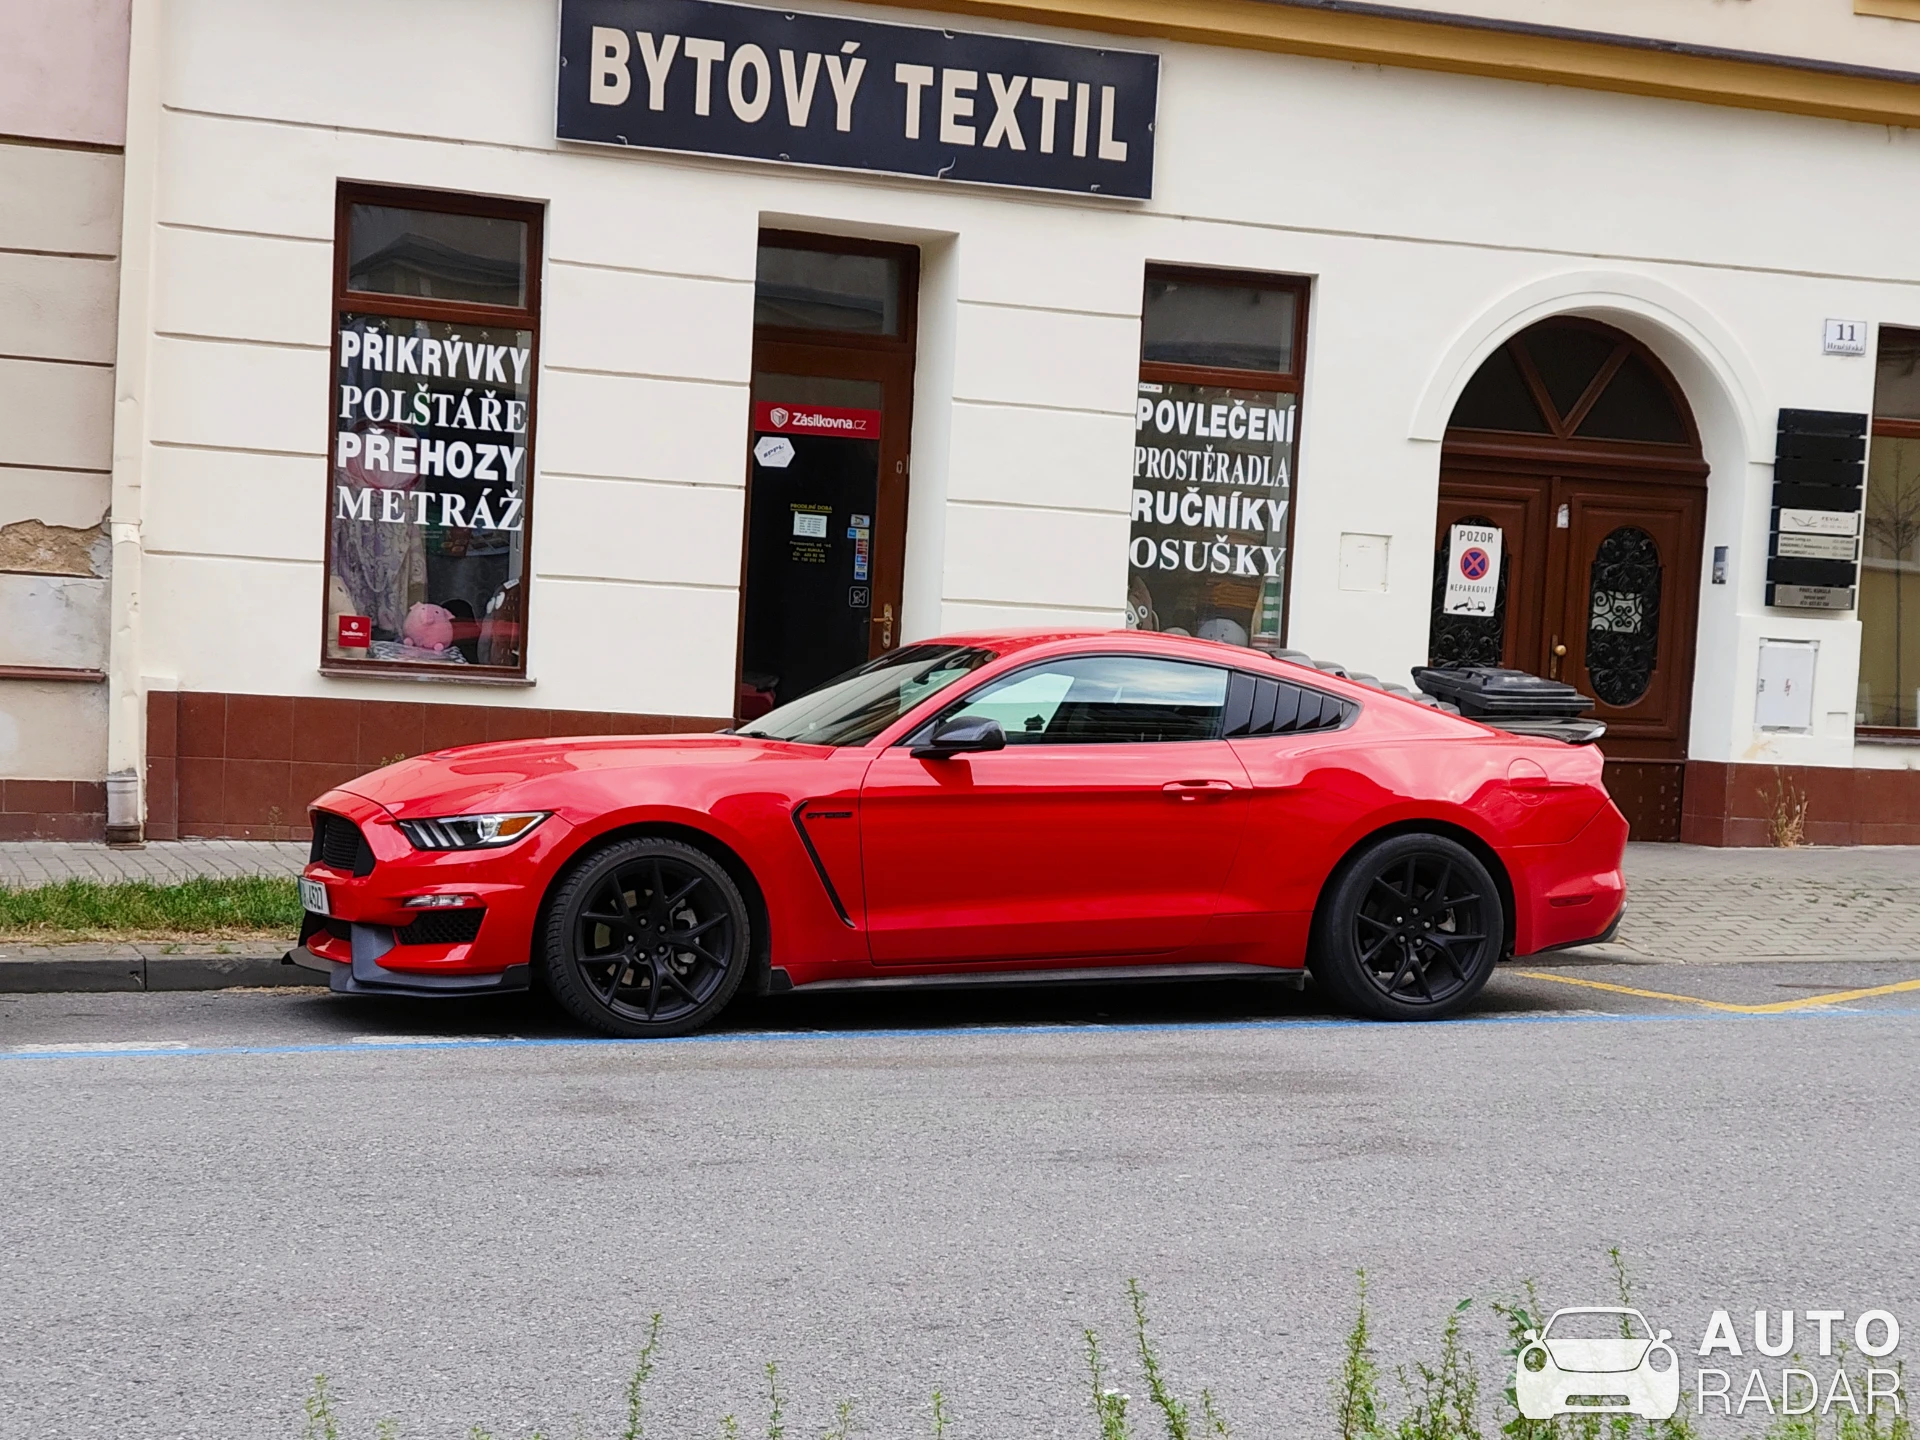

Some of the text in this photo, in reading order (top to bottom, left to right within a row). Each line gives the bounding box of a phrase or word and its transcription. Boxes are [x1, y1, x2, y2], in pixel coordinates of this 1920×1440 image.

[590, 26, 1127, 162] BYTOVÝ TEXTIL
[1836, 323, 1856, 341] 11
[340, 327, 530, 384] PŘIKRÝVKY
[339, 383, 527, 434] POLŠTÁŘE
[1136, 398, 1297, 443] POVLEČENÍ
[337, 428, 525, 482] PŘEHOZY
[1133, 444, 1290, 488] PROSTĚRADLA
[336, 486, 524, 531] METRÁŽ
[1131, 486, 1290, 533] RUČNÍKY
[1129, 534, 1287, 578] OSUŠKY
[1459, 530, 1494, 543] POZOR
[1450, 583, 1495, 594] NEPARKOVAT!
